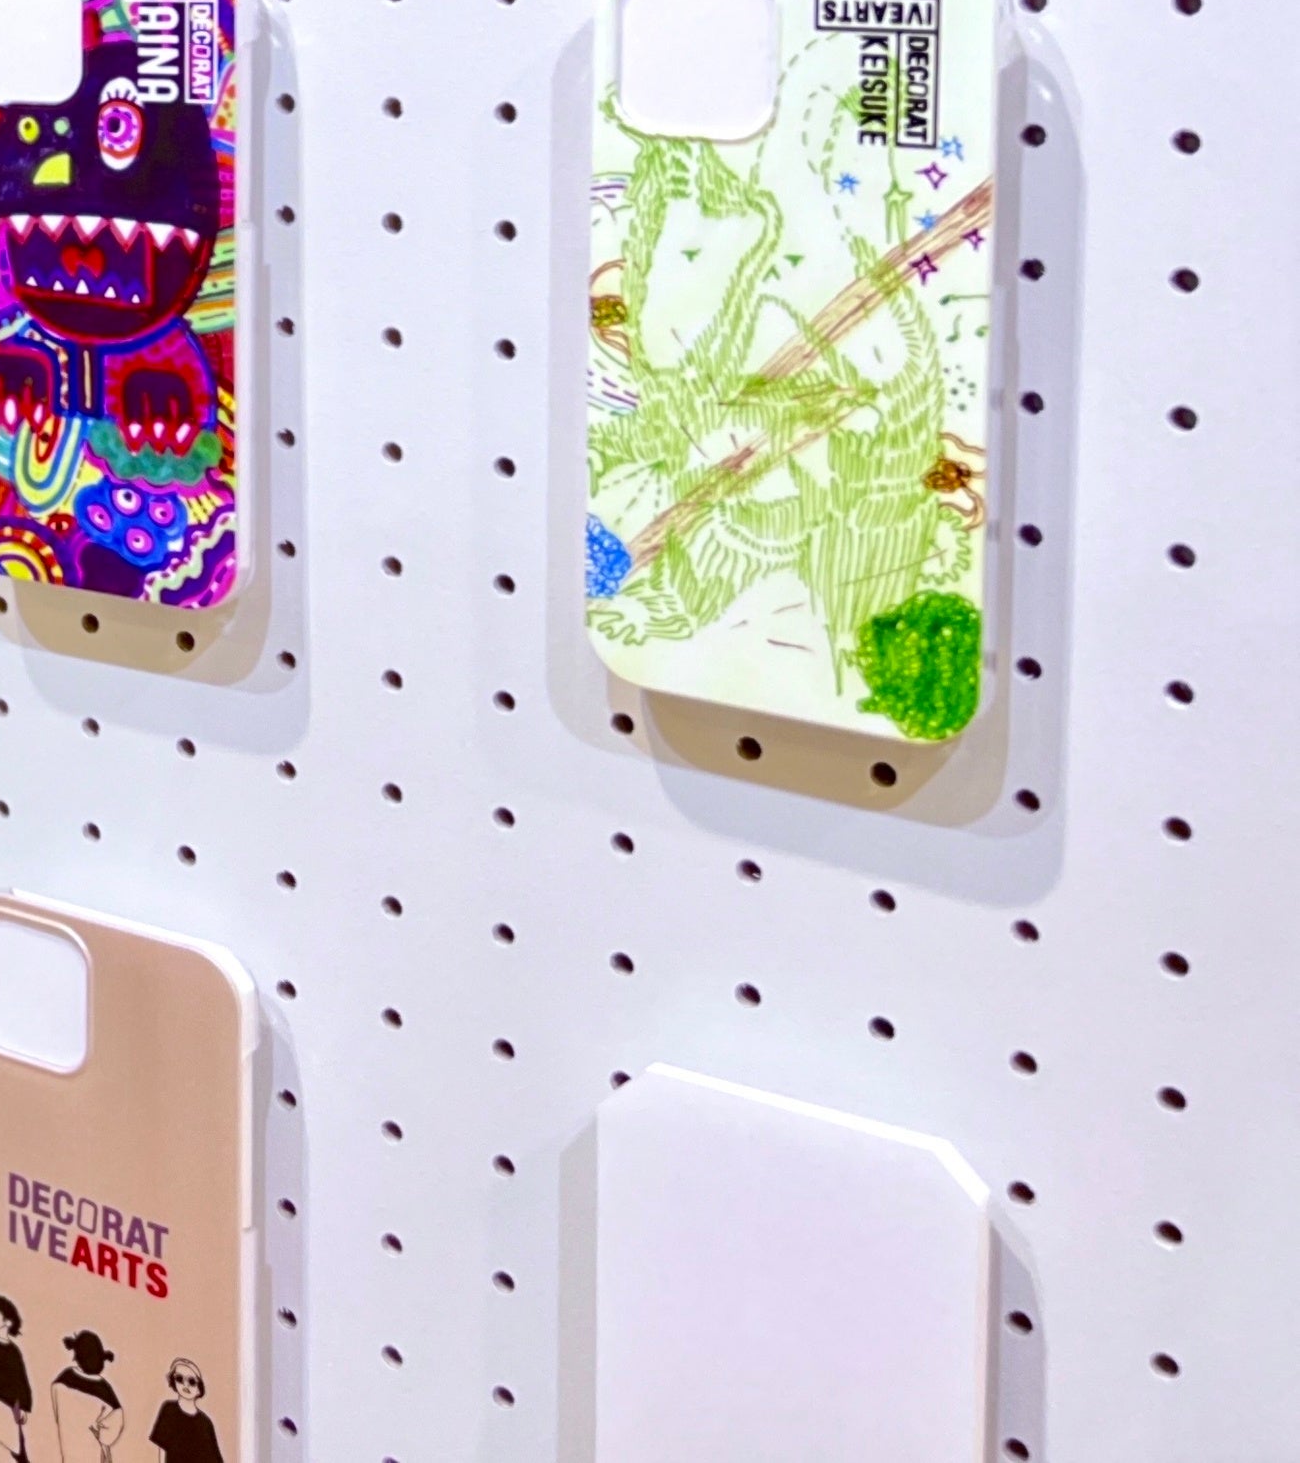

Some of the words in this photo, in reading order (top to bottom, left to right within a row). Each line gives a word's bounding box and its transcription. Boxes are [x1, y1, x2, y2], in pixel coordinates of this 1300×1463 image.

[137, 5, 180, 103] AINA
[191, 4, 212, 98] DECORAT
[824, 0, 932, 25] IVEARTS
[859, 35, 889, 146] KEISUKE
[905, 36, 930, 143] DECORAT
[8, 1171, 169, 1259] DECORAT
[8, 1209, 169, 1299] IVEARTS
